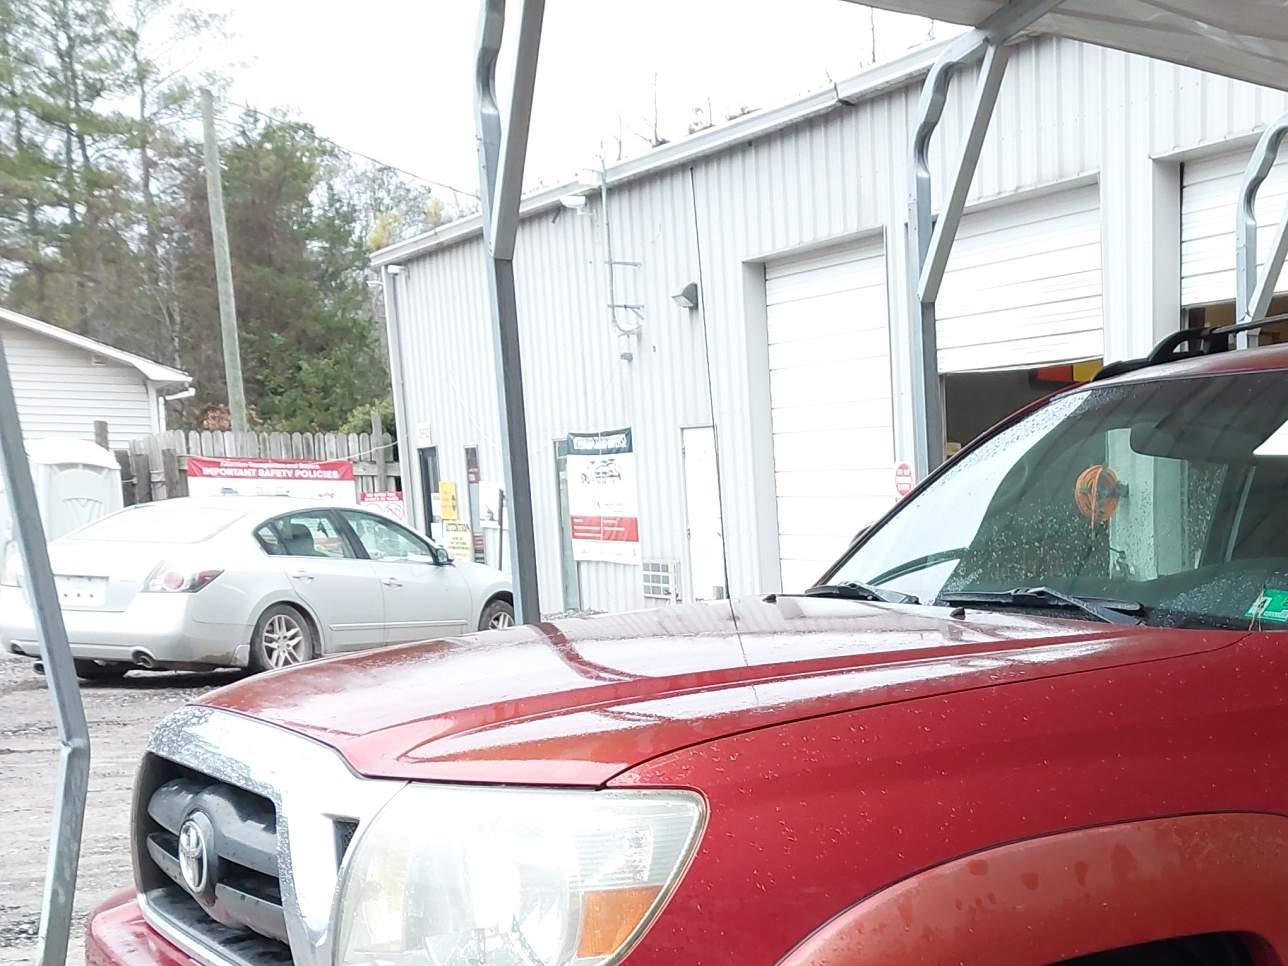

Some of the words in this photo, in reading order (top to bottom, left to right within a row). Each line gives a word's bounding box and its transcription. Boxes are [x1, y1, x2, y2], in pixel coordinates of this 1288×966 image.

[202, 467, 257, 477] IMPORTANT
[258, 468, 293, 478] SAFETY
[295, 469, 339, 479] POLICIES
